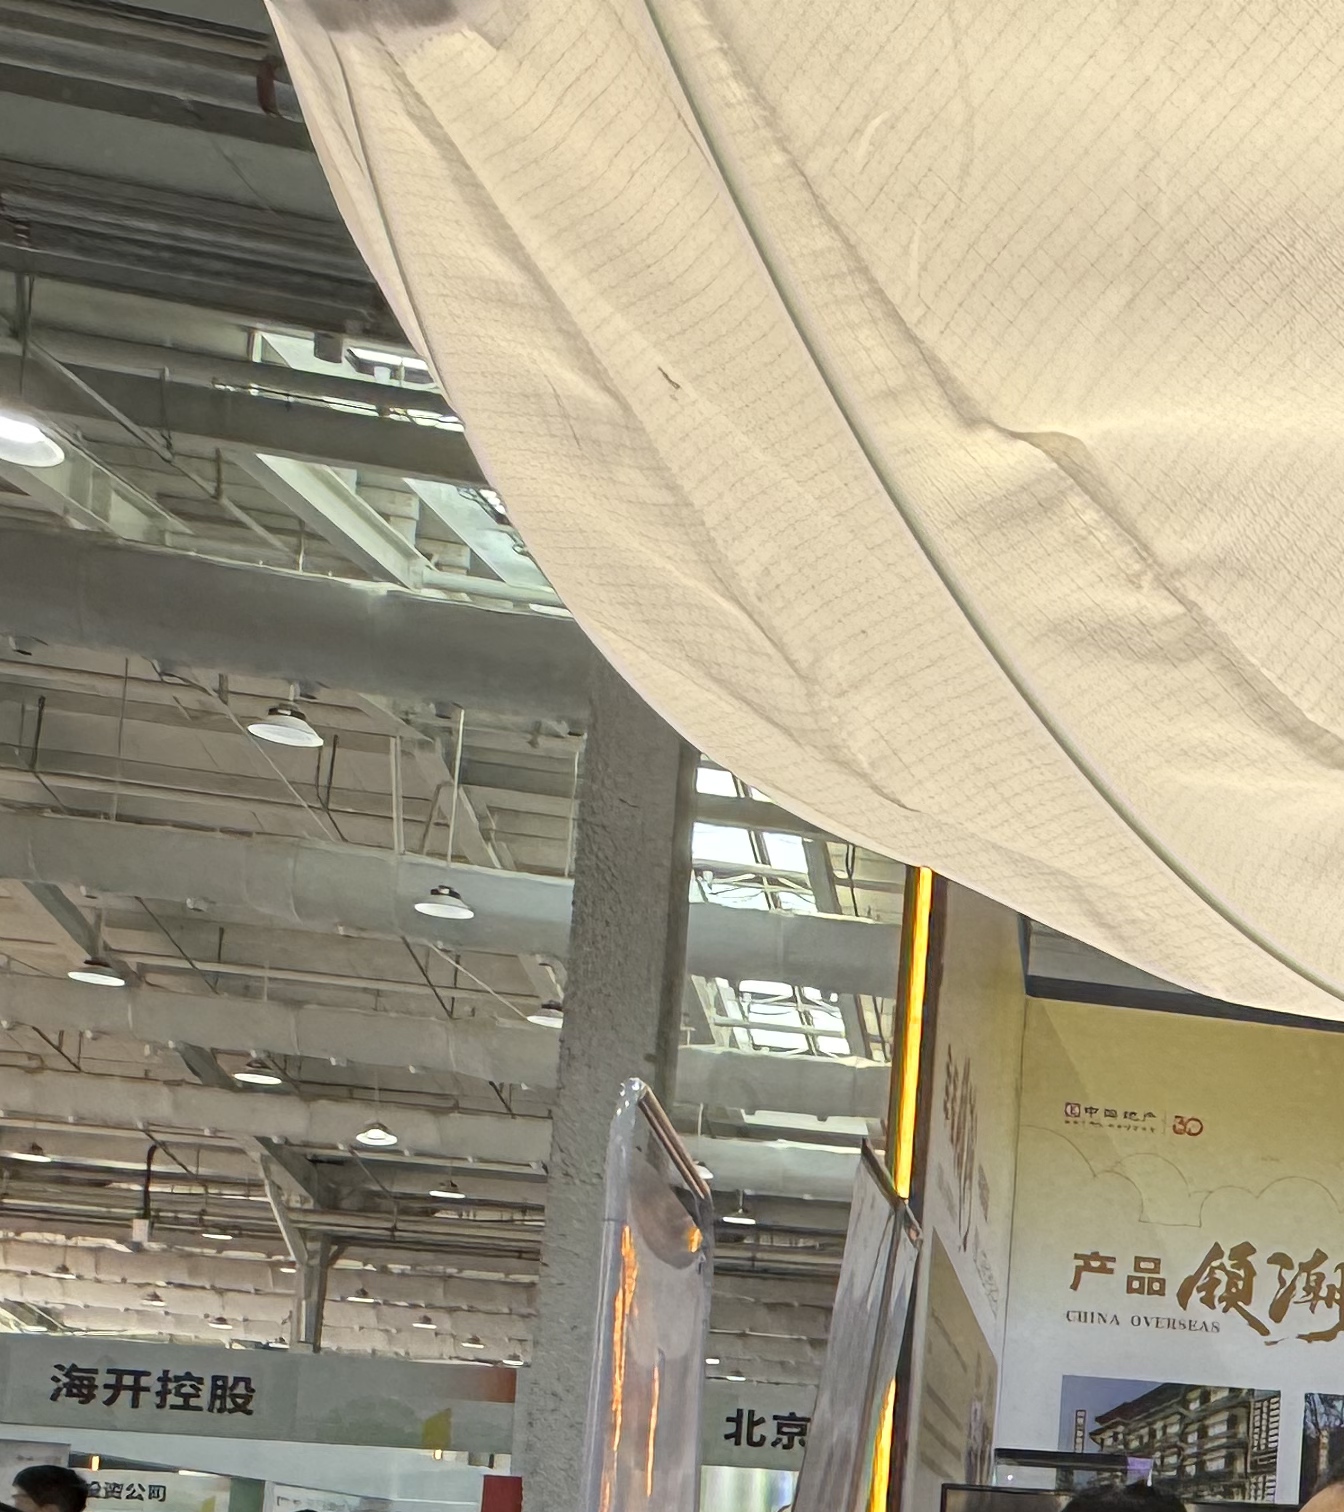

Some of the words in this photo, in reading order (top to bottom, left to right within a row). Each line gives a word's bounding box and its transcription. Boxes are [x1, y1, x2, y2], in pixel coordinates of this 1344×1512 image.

[1065, 1309, 1121, 1327] CHINA
[1130, 1314, 1222, 1334] OVERSEAS
[50, 1363, 256, 1416] 海开控股
[723, 1408, 812, 1450] 北京
